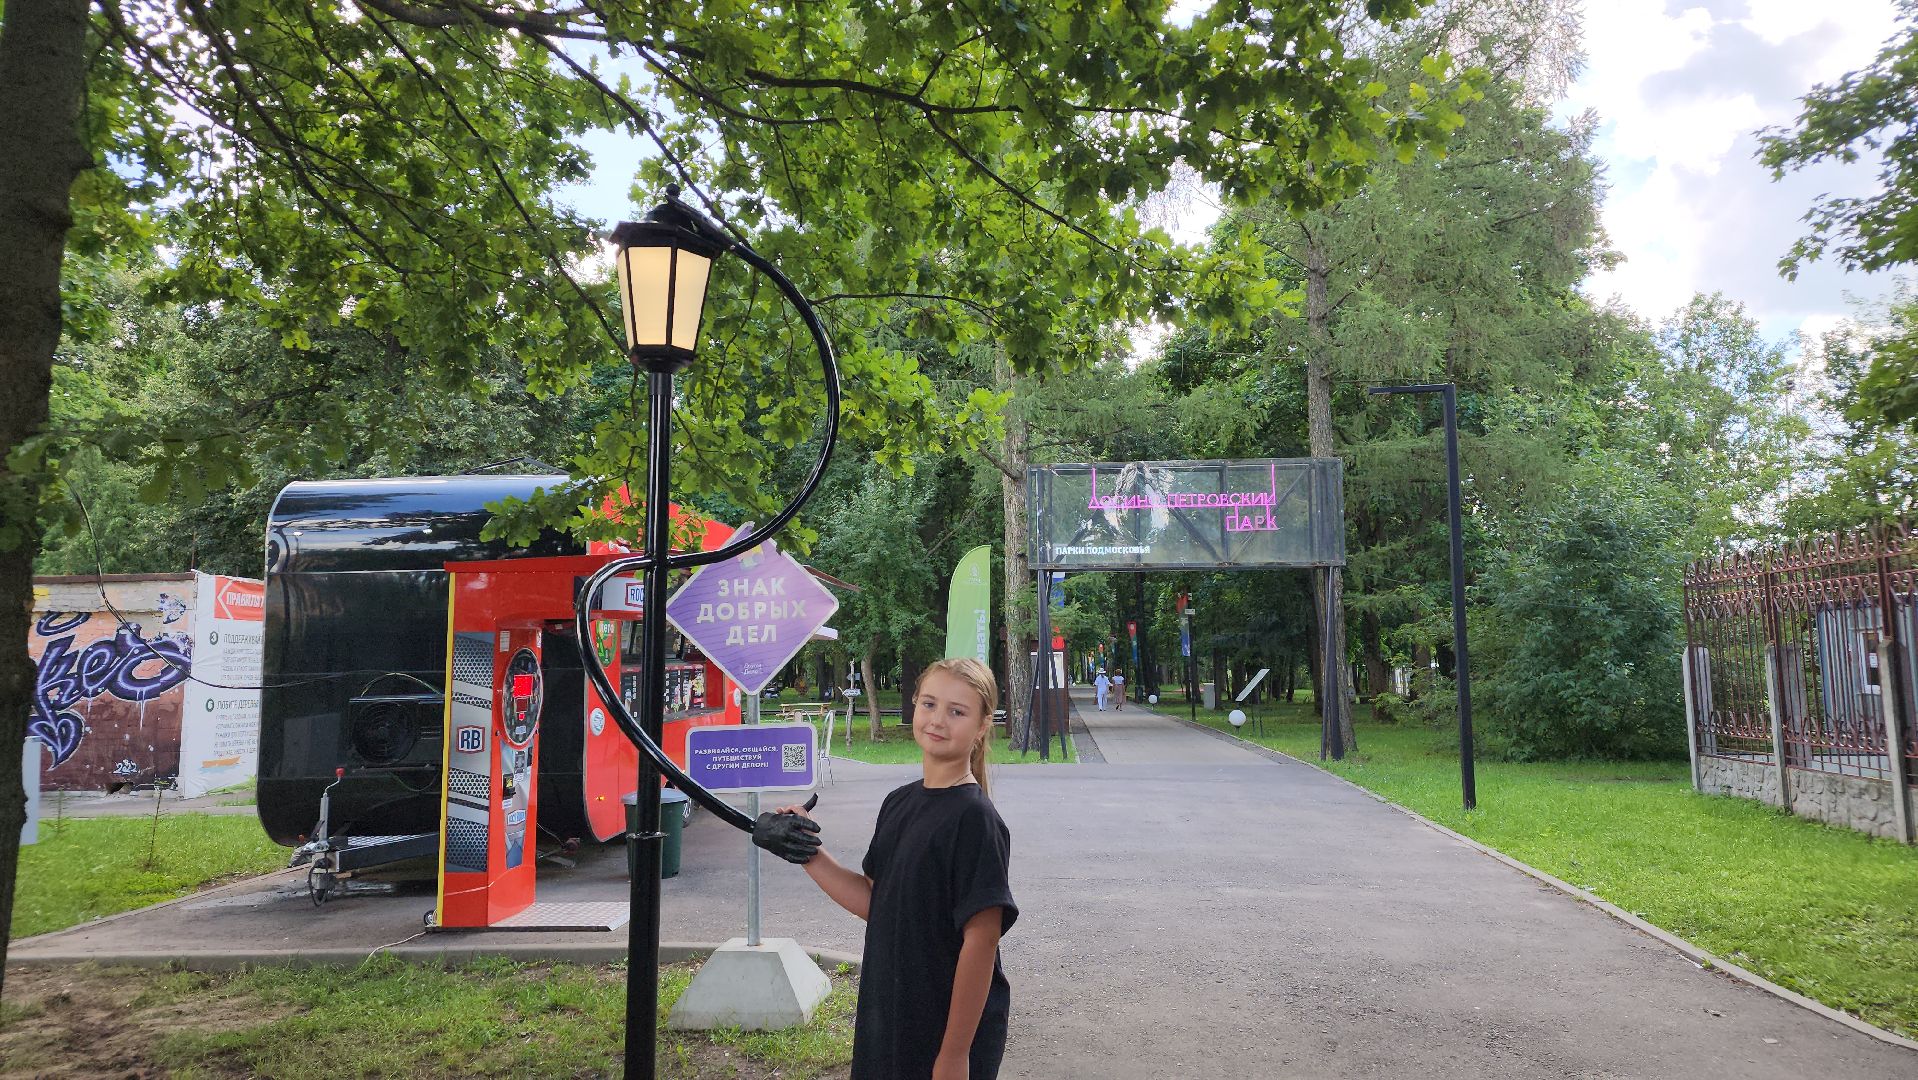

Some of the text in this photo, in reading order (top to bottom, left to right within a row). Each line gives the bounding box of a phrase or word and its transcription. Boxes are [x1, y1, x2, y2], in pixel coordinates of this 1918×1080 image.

[1226, 515, 1280, 531] ПАРК
[1056, 545, 1151, 556] ПАРКИ ПОДМОСКОВЬЯ
[717, 577, 787, 597] ЗНАК
[696, 601, 808, 624] ДОБРЫХ
[725, 624, 778, 646] ДЕЛ
[461, 730, 482, 749] RB
[712, 754, 762, 763] ПУТЕШЕСТВУЙ
